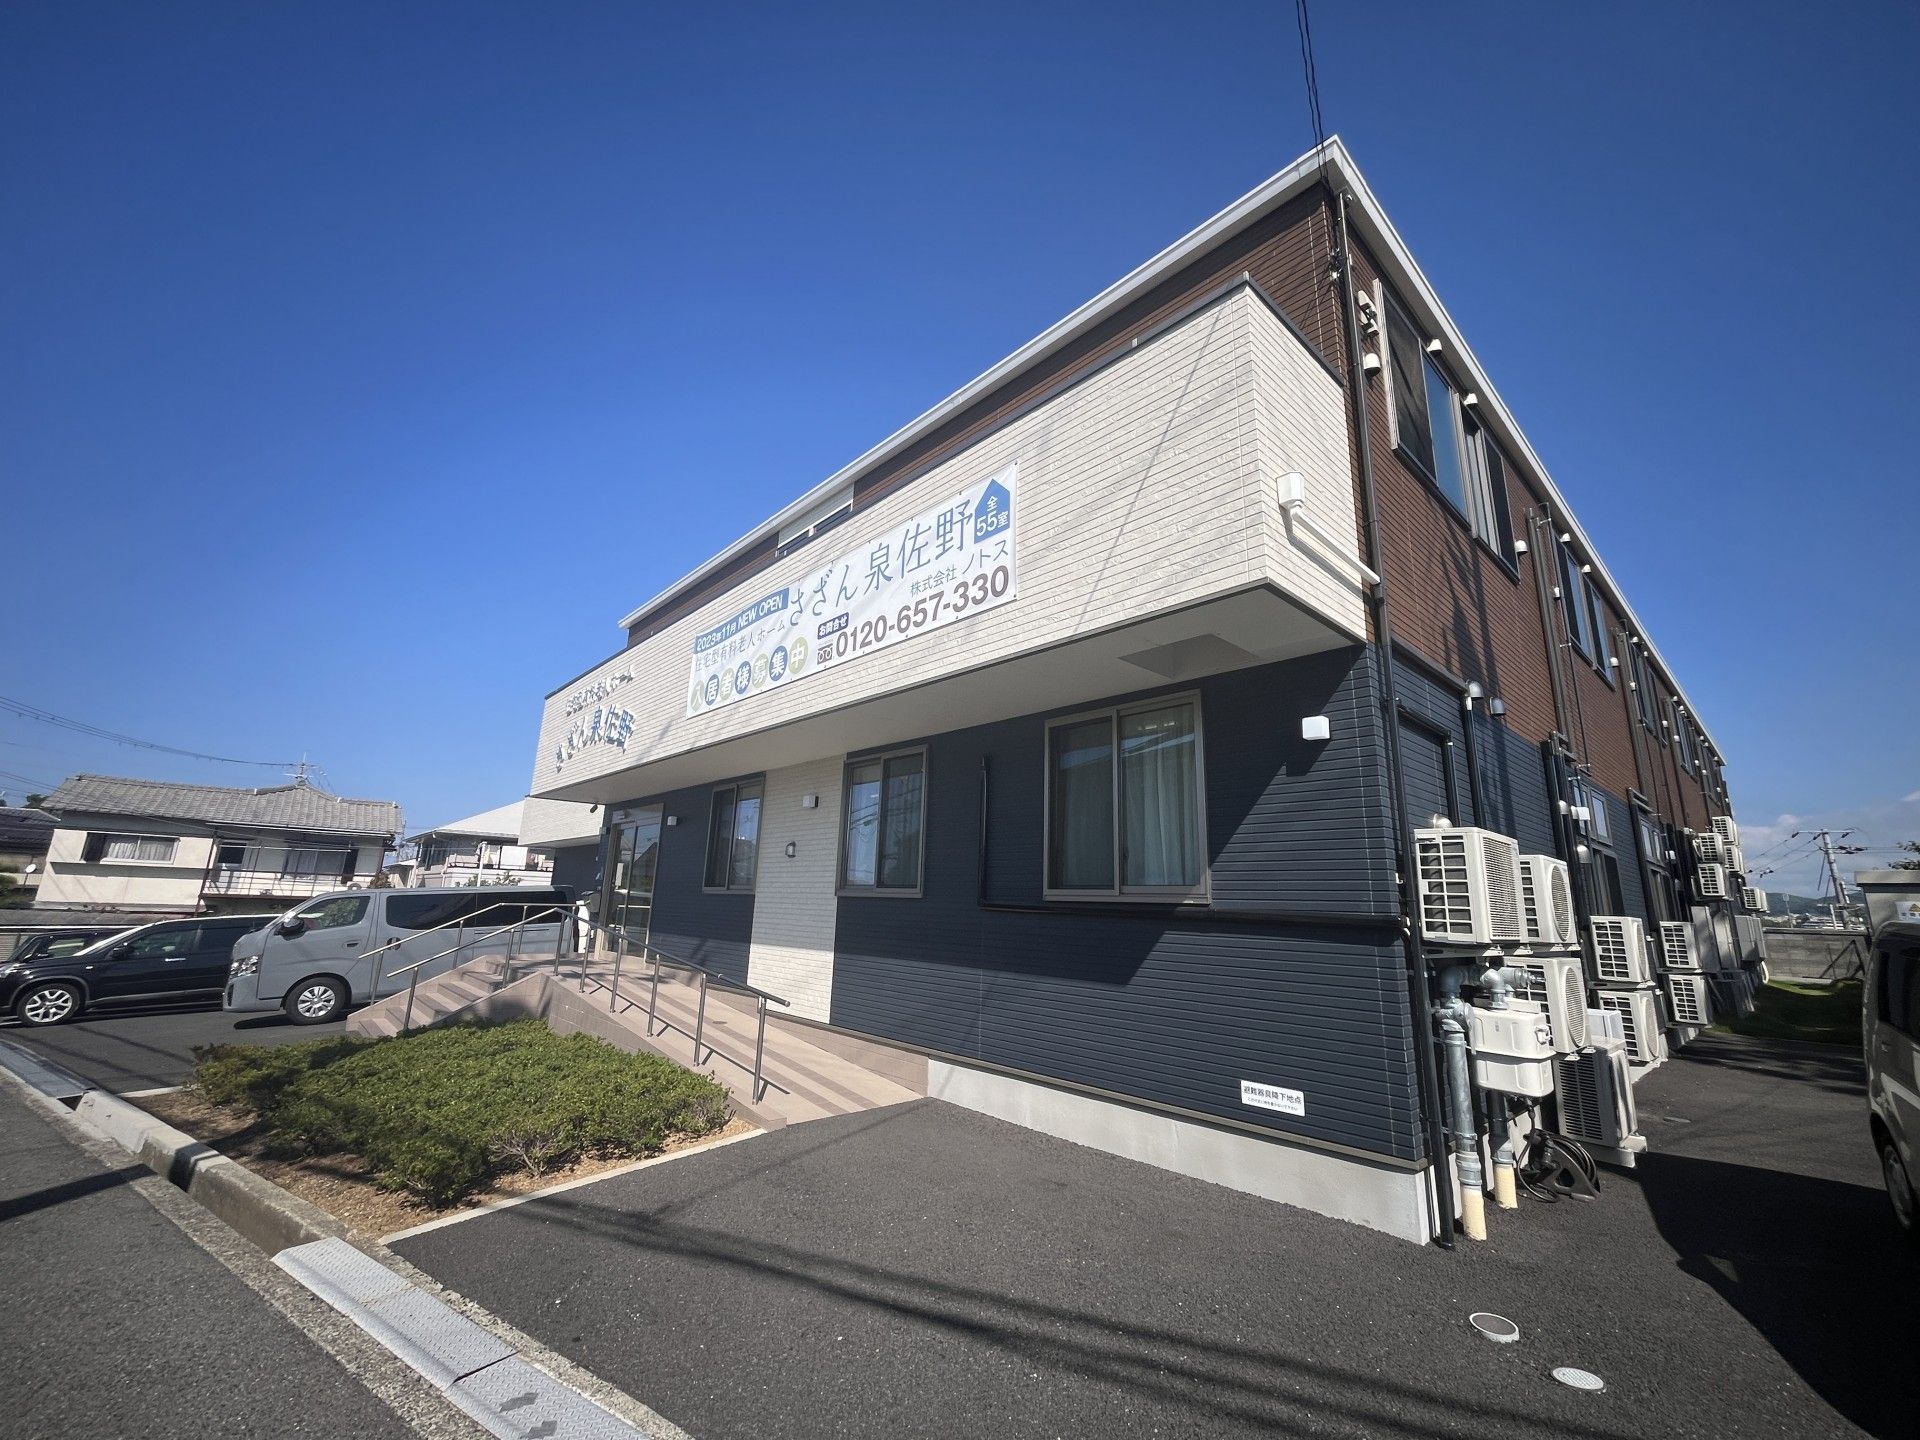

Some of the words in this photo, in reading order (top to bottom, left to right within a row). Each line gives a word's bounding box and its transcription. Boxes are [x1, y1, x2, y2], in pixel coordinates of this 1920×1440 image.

[987, 495, 998, 511] 全
[976, 510, 1009, 537] 55室
[696, 622, 737, 652] 2023年11月
[738, 605, 758, 630] NEW
[758, 593, 783, 617] OPEN
[836, 565, 1010, 658] 0120-657-330
[818, 615, 848, 637] お問合せ
